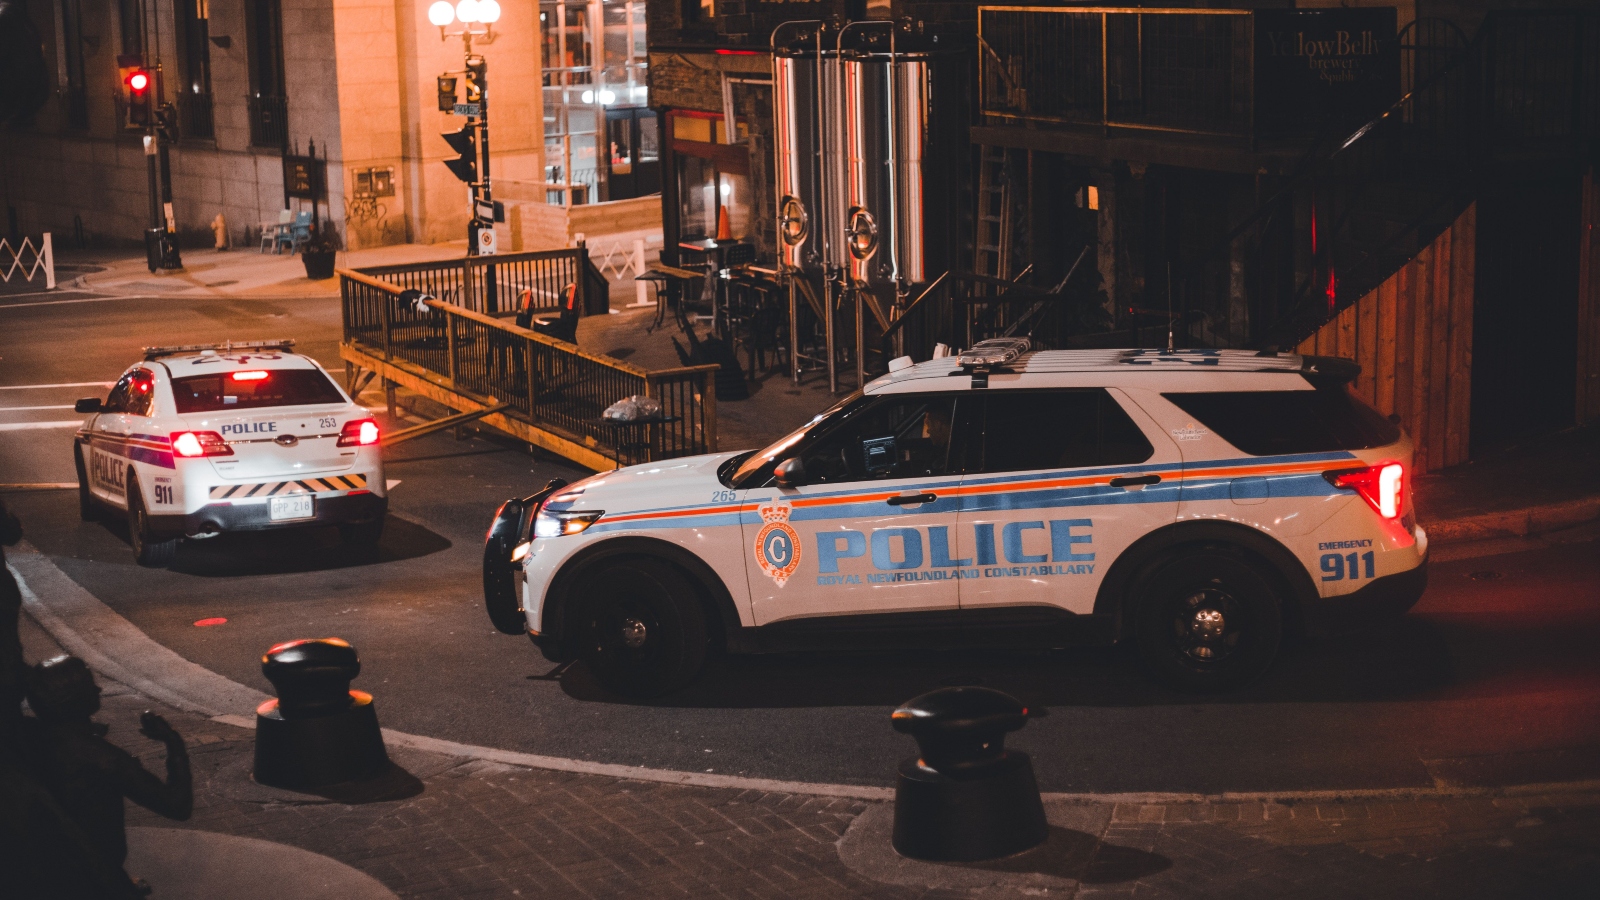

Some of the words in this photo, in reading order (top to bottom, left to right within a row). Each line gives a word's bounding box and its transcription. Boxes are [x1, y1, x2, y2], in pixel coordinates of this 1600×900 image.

[221, 421, 277, 435] POLICE
[319, 418, 337, 428] 253
[95, 452, 125, 489] POLICE
[155, 484, 173, 504] 911
[711, 490, 737, 502] 265
[273, 502, 288, 513] GPP
[293, 501, 310, 512] 218
[757, 522, 792, 546] NEWFOUNDLAND
[1318, 539, 1373, 551] EMERGENCY
[768, 536, 786, 563] C
[815, 518, 1096, 574] POLICE
[817, 574, 863, 586] ROYAL
[867, 568, 981, 584] NEWFOUNDLAND
[984, 564, 1096, 578] CONSTABULARY
[1320, 551, 1375, 582] 911
